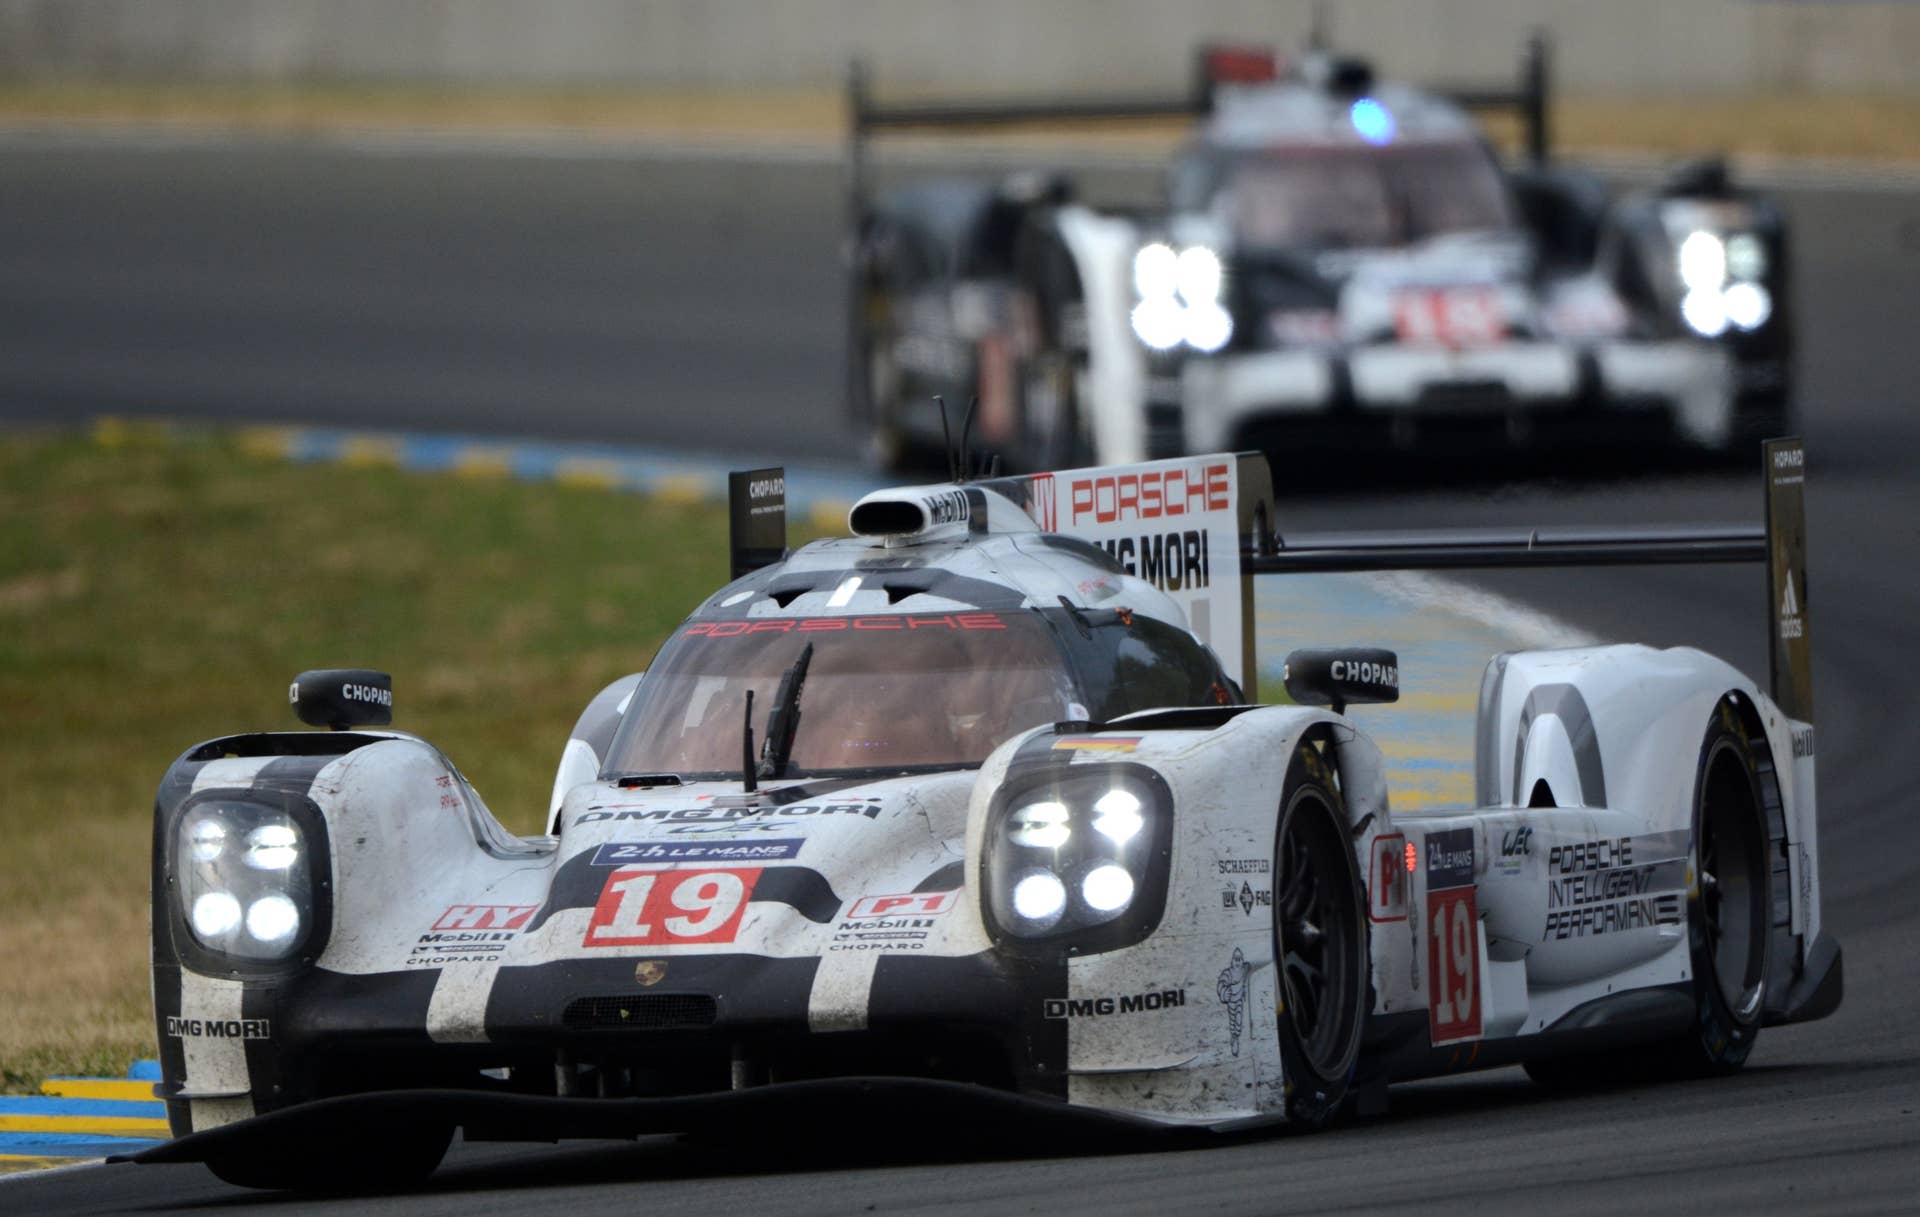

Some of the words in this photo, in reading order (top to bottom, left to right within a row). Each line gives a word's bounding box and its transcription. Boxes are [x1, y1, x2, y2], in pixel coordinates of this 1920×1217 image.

[750, 478, 784, 498] CHOPARD
[1071, 464, 1229, 527] PORSCHE
[1140, 528, 1209, 592] MORI
[680, 613, 1006, 641] PORSCHE
[573, 808, 708, 827] DMG
[712, 803, 882, 819] MORI
[707, 846, 790, 855] MANS
[1502, 827, 1533, 857] WEC
[1219, 858, 1270, 874] SCHAEFFLER
[1549, 837, 1633, 877] PORSCHE
[1548, 865, 1656, 910] INTELLIGENT
[437, 905, 533, 928] HY
[593, 873, 745, 938] 19
[871, 896, 946, 914] P1
[839, 920, 909, 930] Mobil
[419, 932, 488, 943] Mobil
[829, 943, 925, 951] CHOPARD
[406, 955, 499, 965] CHOPARD
[1433, 899, 1473, 1025] 19
[1046, 997, 1116, 1018] DMG
[1119, 989, 1186, 1014] MORI
[167, 1018, 202, 1036] DMG
[206, 1020, 269, 1038] MORI
